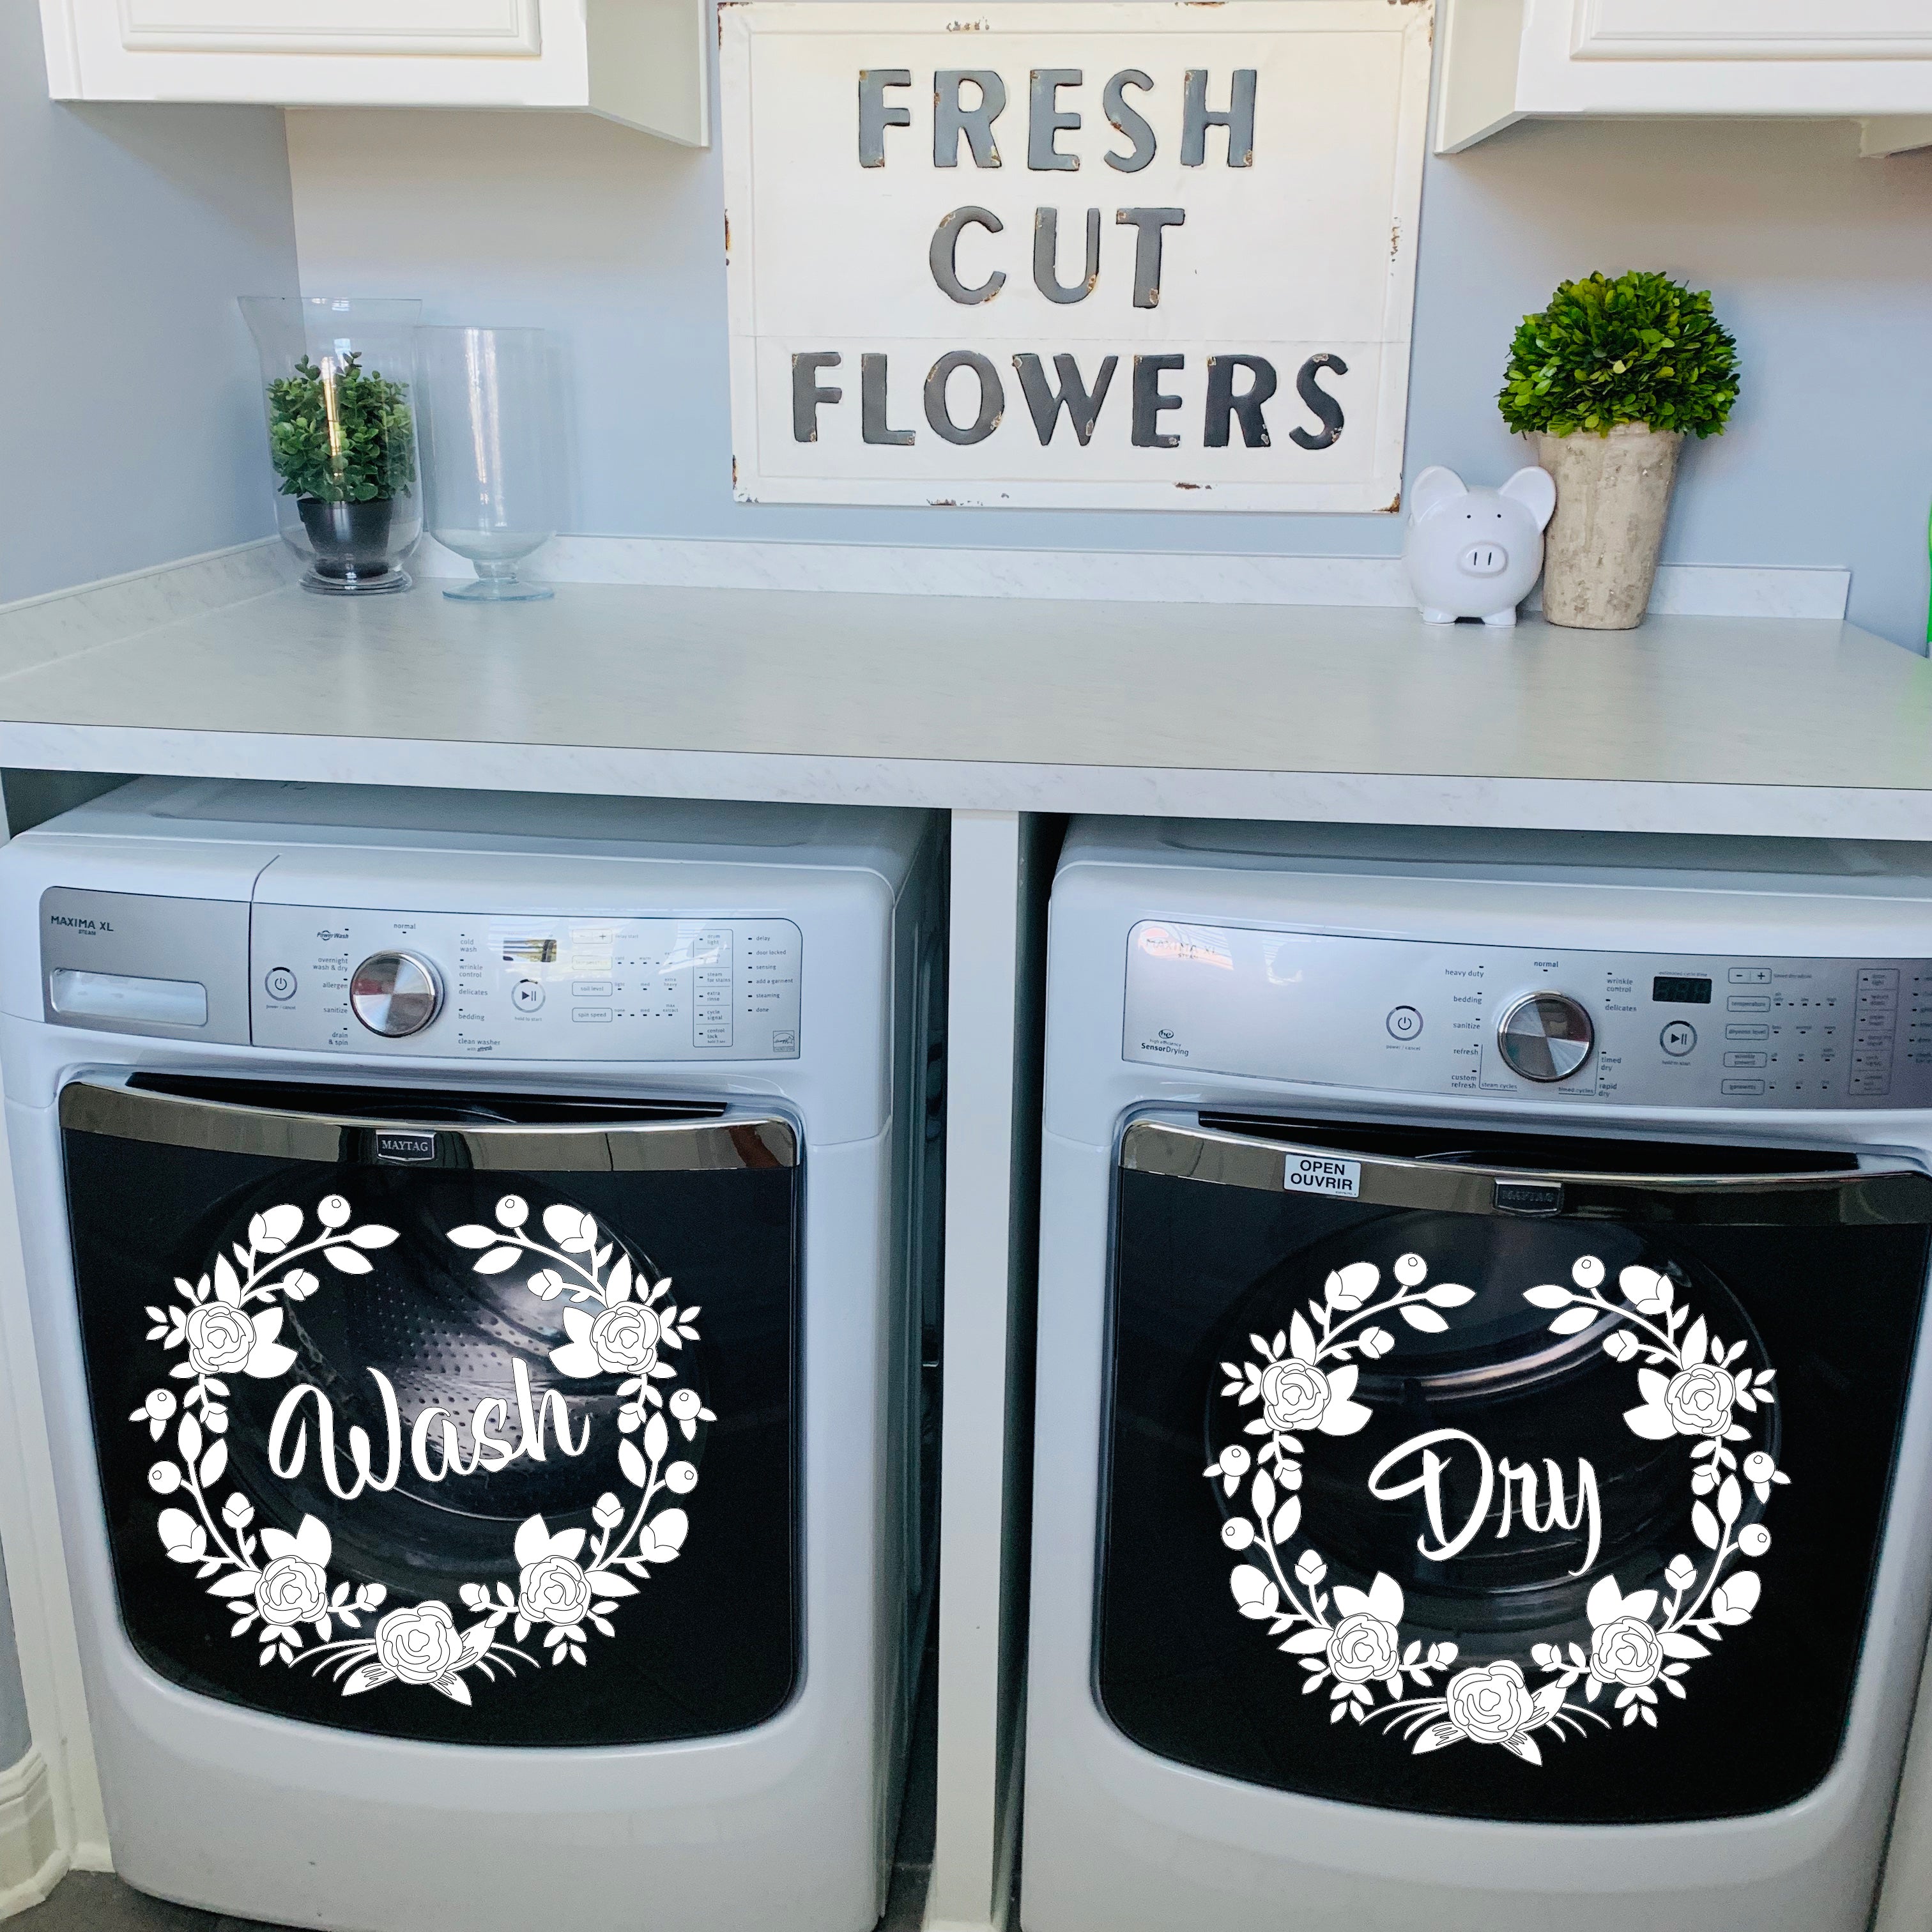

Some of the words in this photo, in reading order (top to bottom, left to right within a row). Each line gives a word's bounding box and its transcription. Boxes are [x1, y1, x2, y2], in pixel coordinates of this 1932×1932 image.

[858, 68, 1257, 173] FRESH
[929, 206, 1185, 309] CUT
[792, 349, 1349, 450] FLOWERS
[50, 916, 95, 930] MAXIMA
[100, 921, 114, 931] XL
[1445, 969, 1466, 977] heavy
[1468, 970, 1484, 978] duty
[1453, 995, 1482, 1004] bedding
[458, 1013, 485, 1022] bedding
[1141, 1043, 1189, 1057] SensorDrying
[381, 1140, 429, 1152] MAYTAG
[1300, 1160, 1345, 1176] OPEN
[1291, 1173, 1353, 1190] OUVRIR
[268, 1356, 590, 1500] Wash
[1368, 1428, 1602, 1577] Dry
